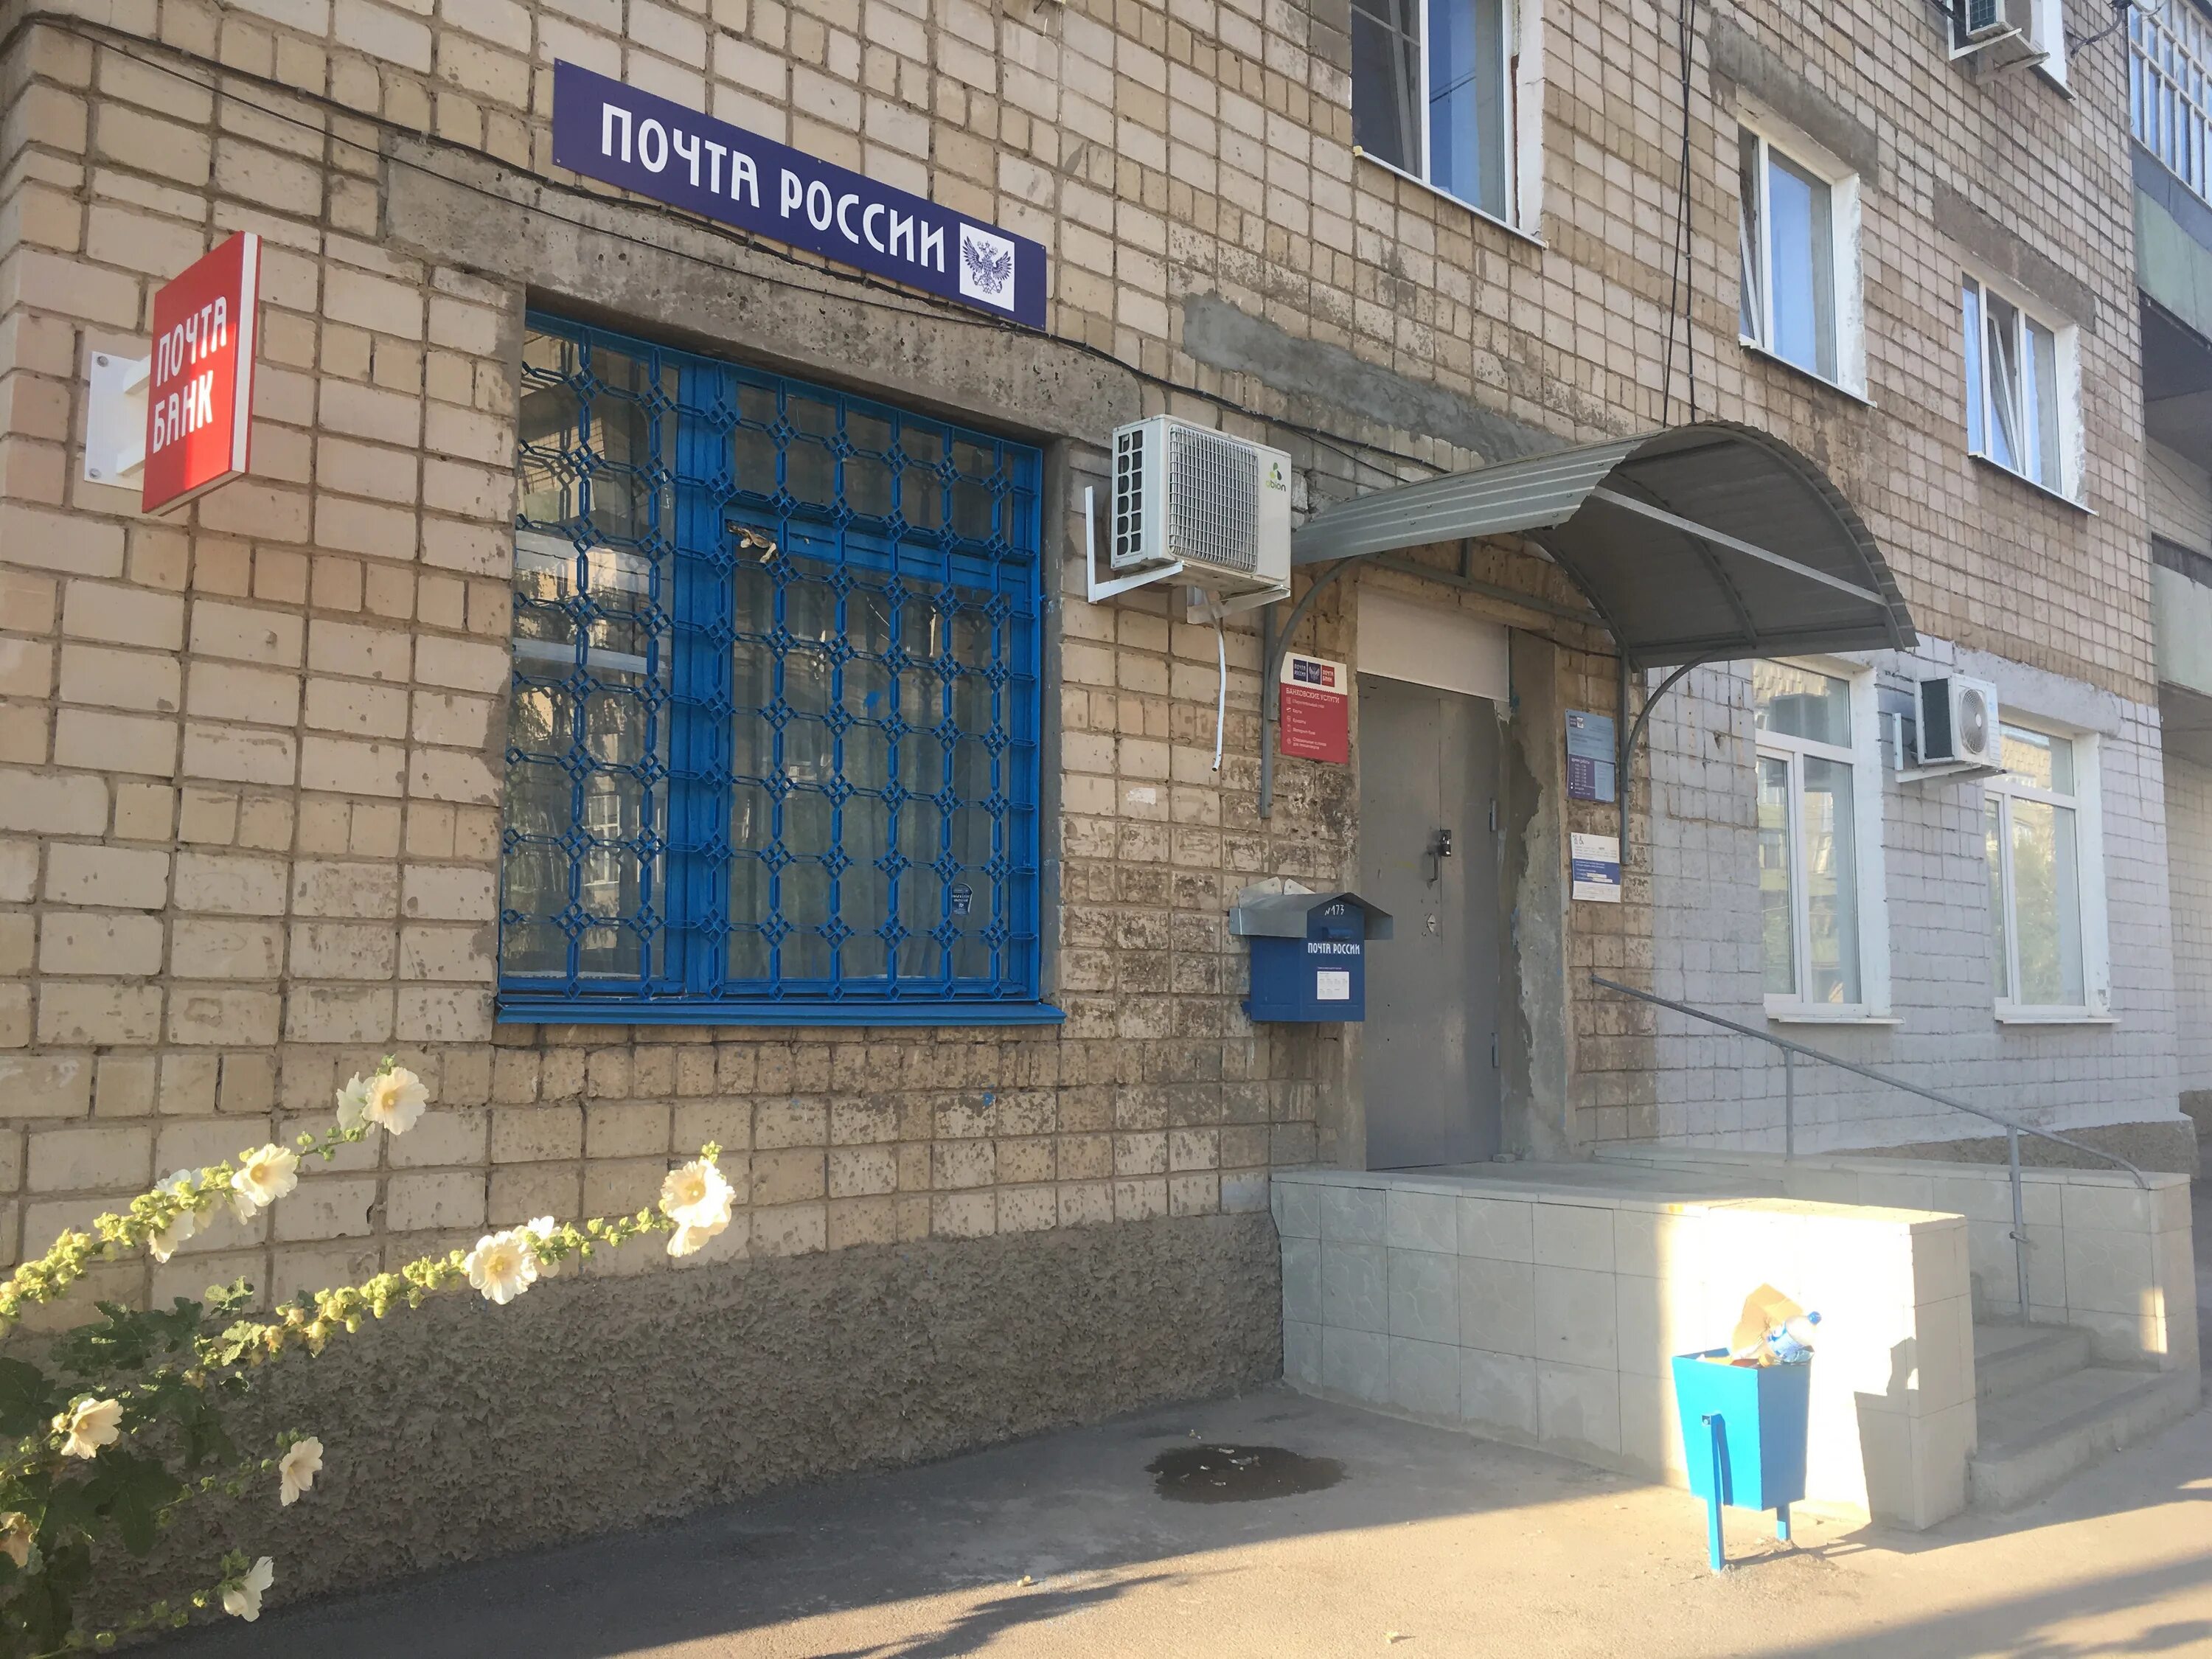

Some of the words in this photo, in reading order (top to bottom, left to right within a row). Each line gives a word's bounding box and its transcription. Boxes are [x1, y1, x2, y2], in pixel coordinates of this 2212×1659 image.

[602, 102, 760, 209] ПОЧТА
[780, 168, 945, 274] РОССИИ
[156, 296, 228, 388] ПОЧТА
[153, 370, 214, 454] БАНК
[1286, 687, 1320, 700] БАНКОВСКИЕ
[1320, 694, 1340, 703] УСЛУГИ
[1307, 942, 1332, 954] ПОЧТА
[1332, 943, 1360, 955] РОССИИ
